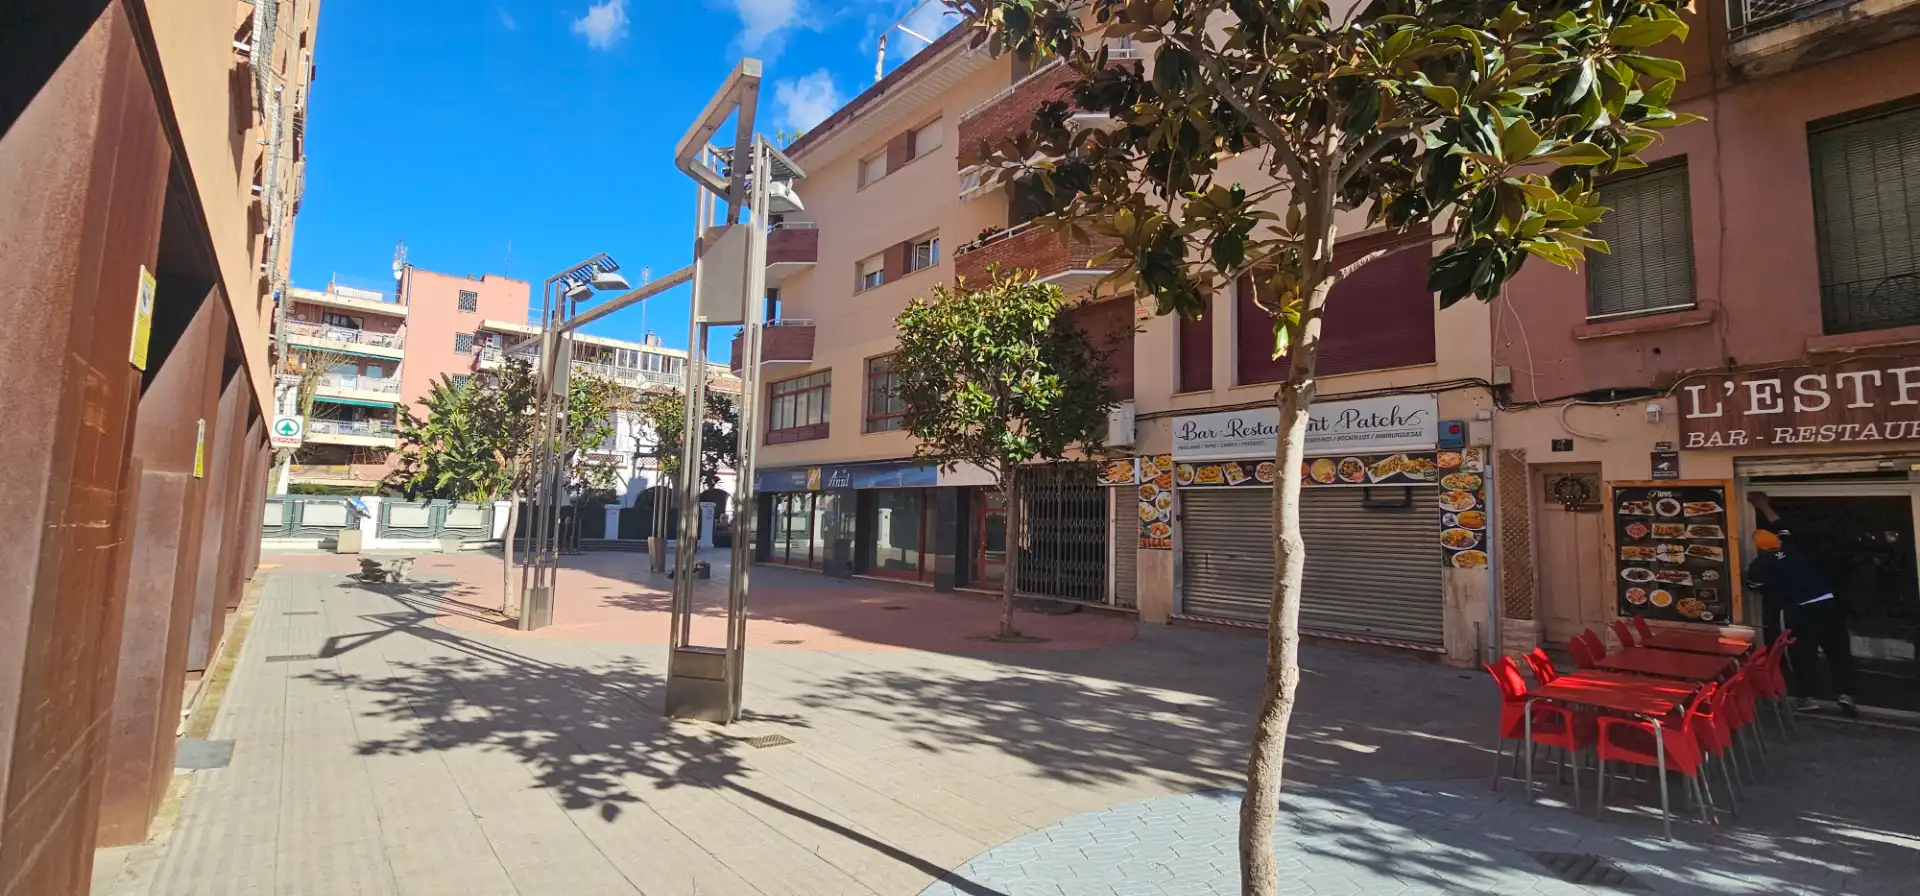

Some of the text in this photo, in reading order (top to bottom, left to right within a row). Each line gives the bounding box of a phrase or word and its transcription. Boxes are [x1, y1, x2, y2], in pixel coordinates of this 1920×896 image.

[1174, 405, 1429, 441] Bar Restant Patch
[1337, 433, 1371, 442] BOCADILLOS
[1375, 430, 1423, 440] HAMBURGUESAS
[1685, 429, 1748, 448] BAR
